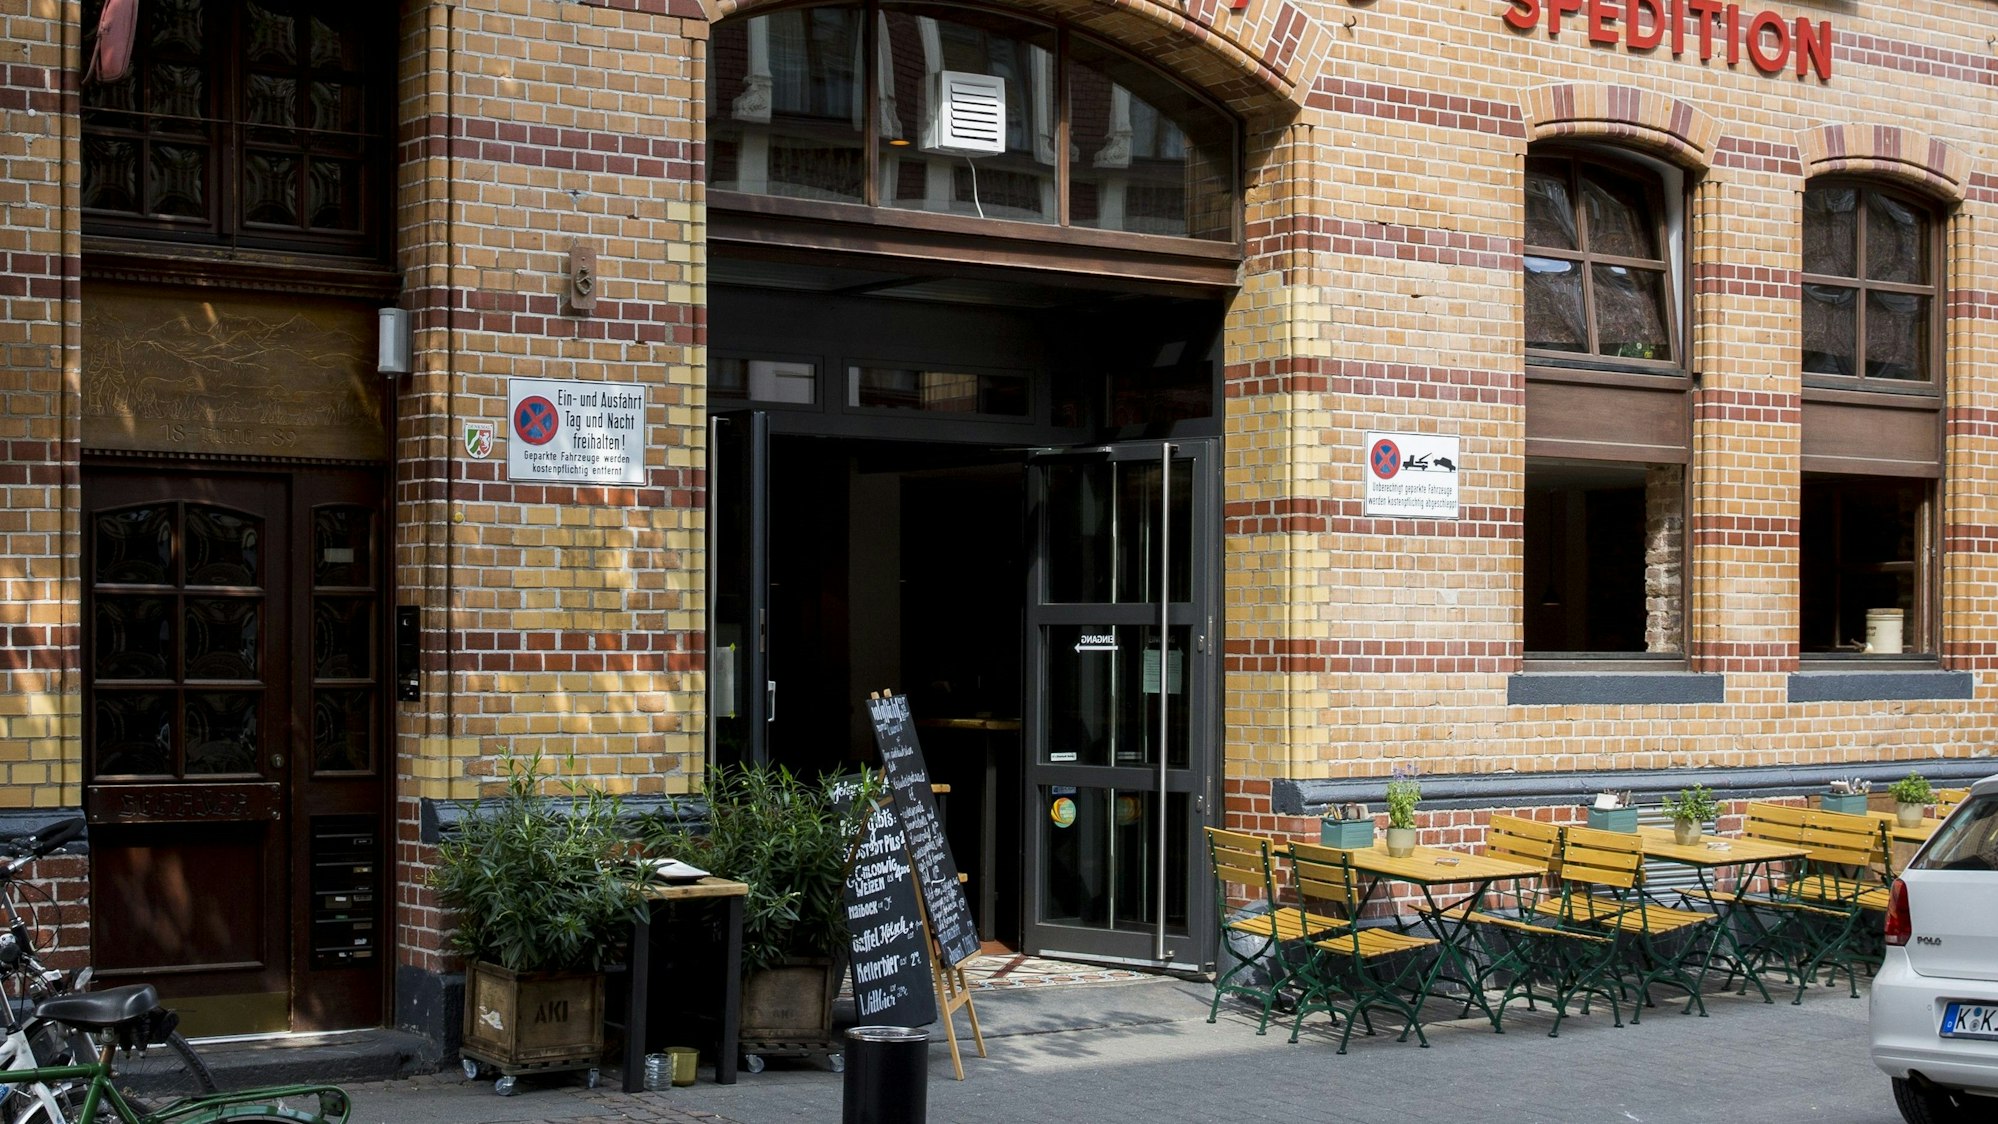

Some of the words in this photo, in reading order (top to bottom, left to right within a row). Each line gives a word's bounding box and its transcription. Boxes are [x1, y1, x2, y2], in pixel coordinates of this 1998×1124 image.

[558, 390, 577, 406] Ein-
[580, 391, 597, 407] und
[600, 392, 642, 410] Ausfahrt
[566, 410, 581, 431] Tag
[586, 412, 603, 428] und
[607, 413, 635, 430] Nacht
[524, 450, 557, 462] Geparkte
[561, 452, 600, 465] Fahrzeuge
[604, 454, 630, 464] werden
[532, 463, 589, 477] kostenpflichtig
[592, 465, 622, 475] entfernt
[1372, 482, 1404, 495] Unberechtigt
[1405, 484, 1427, 495] geparkte
[1428, 484, 1453, 497] Fahrzeuge
[1368, 496, 1386, 506] werden
[1387, 496, 1424, 510] kostenpflichtig
[1917, 936, 1942, 946] POLO
[535, 1000, 568, 1024] AKI
[1955, 1008, 1972, 1030] K
[1980, 1009, 1998, 1032] K
